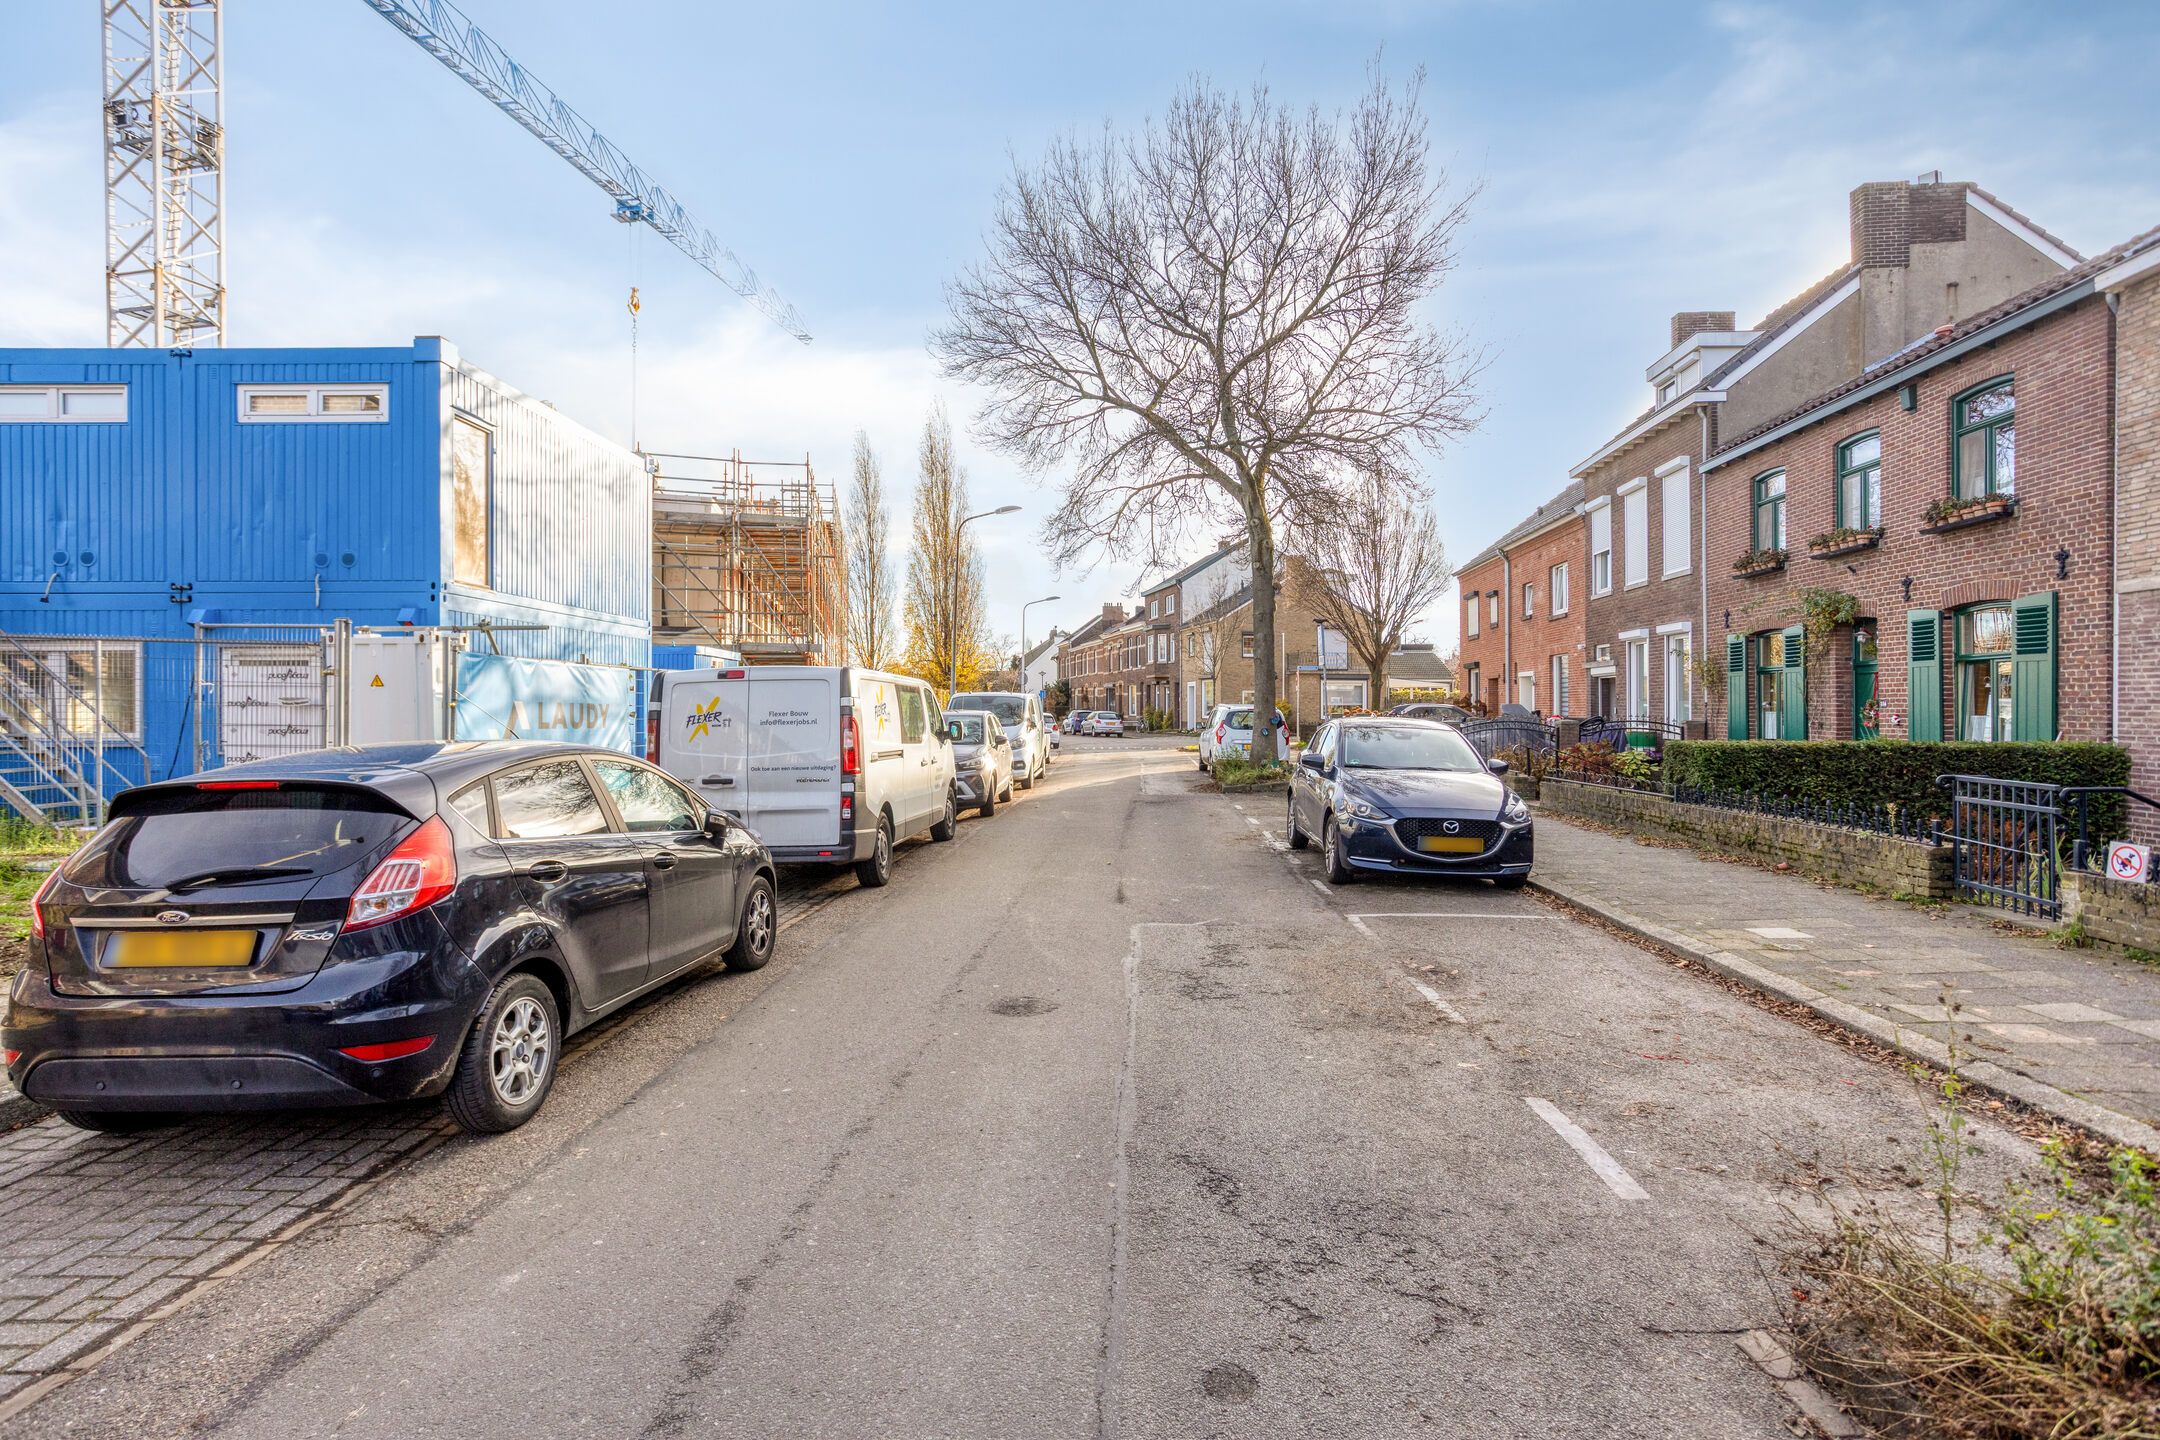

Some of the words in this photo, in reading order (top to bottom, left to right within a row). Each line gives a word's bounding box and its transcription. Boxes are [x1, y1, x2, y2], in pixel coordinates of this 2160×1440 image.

[538, 702, 609, 730] LAUDY
[686, 711, 722, 728] FLEXER
[759, 718, 818, 726] info@flexerjobs.nl
[161, 913, 181, 922] Ford
[285, 929, 334, 941] Fiesta
